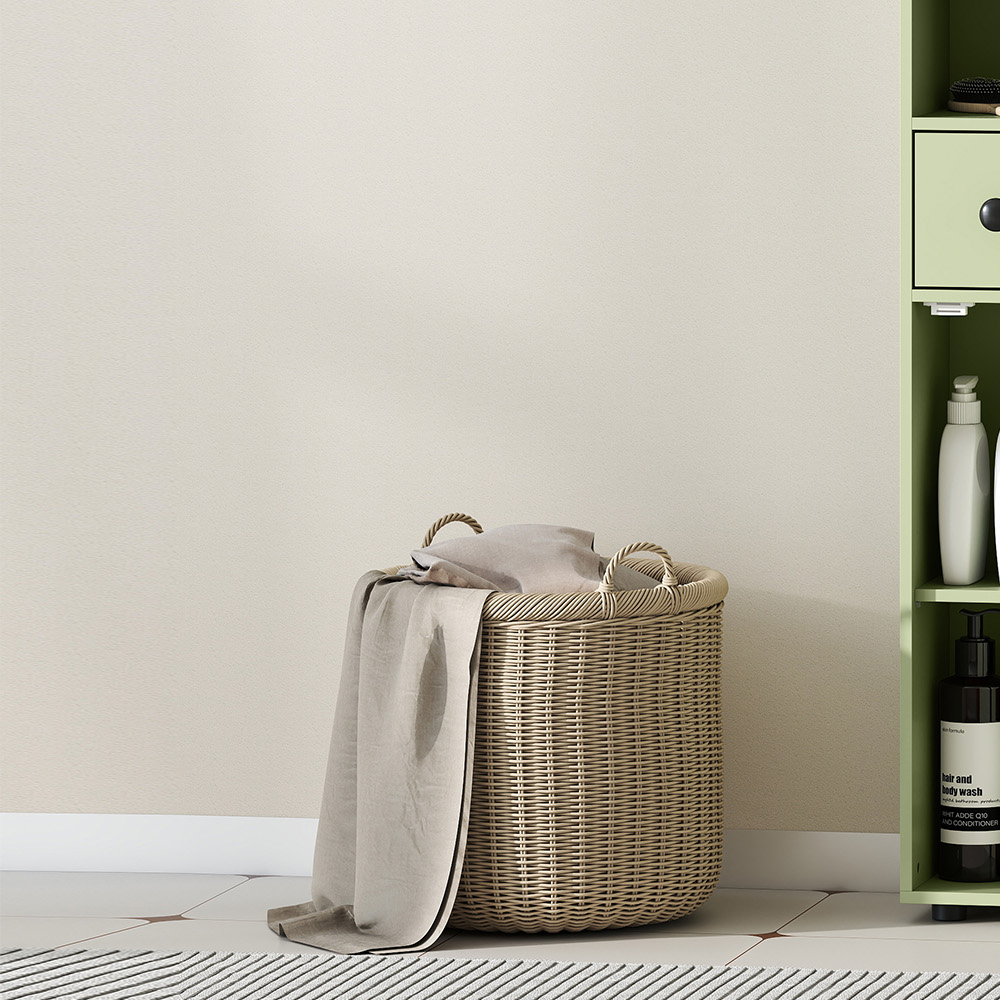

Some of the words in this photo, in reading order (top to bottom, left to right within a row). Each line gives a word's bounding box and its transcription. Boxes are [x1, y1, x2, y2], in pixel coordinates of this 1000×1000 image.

[942, 772, 954, 783] hair
[955, 775, 972, 784] and
[942, 784, 958, 797] body
[959, 787, 983, 797] wash
[955, 812, 974, 820] ADDE
[975, 812, 989, 820] Q10
[953, 819, 999, 828] CONDITIONER
